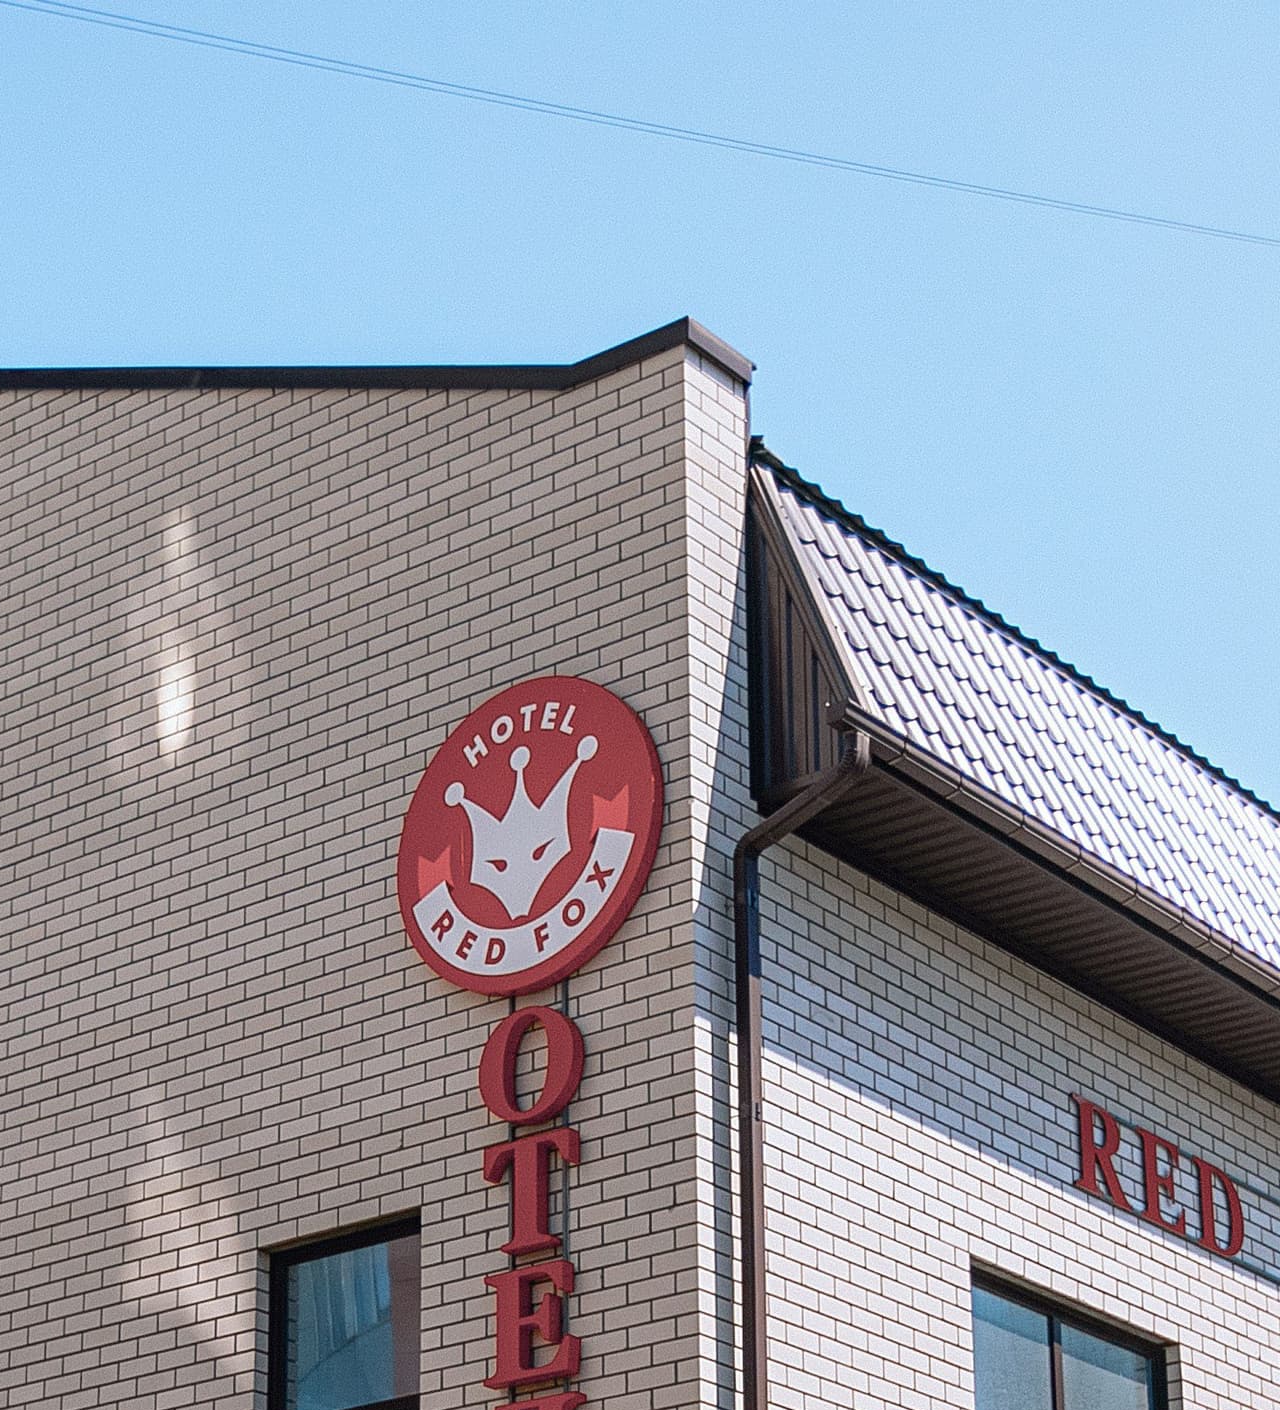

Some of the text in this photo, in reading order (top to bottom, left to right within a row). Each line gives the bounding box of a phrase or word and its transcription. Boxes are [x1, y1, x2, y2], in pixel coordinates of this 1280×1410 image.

[463, 702, 577, 767] HOTEL
[430, 859, 615, 966] RED FOX
[1070, 1092, 1245, 1258] RED
